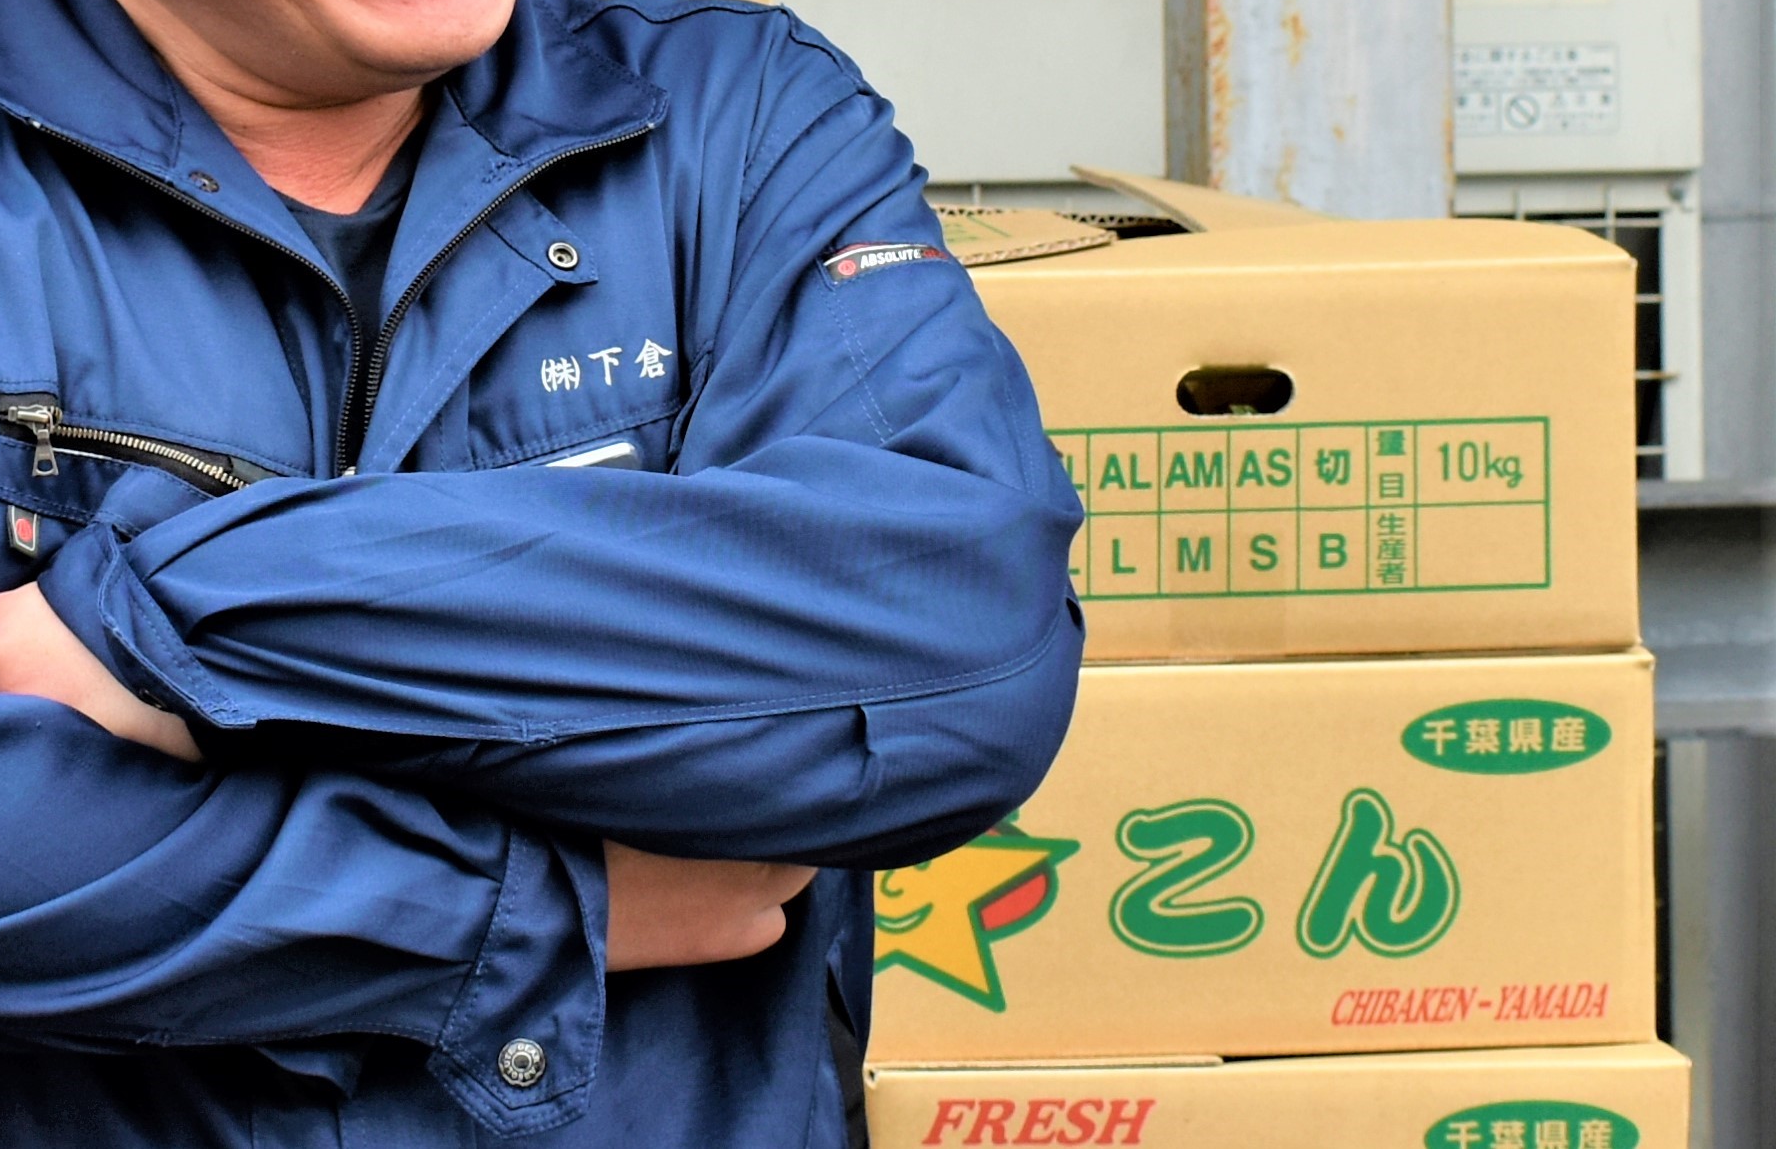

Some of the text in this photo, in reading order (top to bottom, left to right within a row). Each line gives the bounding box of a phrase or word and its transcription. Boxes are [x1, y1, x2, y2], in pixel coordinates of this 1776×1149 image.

[860, 249, 922, 269] ABSOLUTE
[1099, 453, 1153, 490] AL
[1165, 451, 1224, 488] AM
[1236, 448, 1293, 488] AS
[1315, 448, 1352, 486] 切
[1439, 441, 1524, 489] 10kg
[1111, 538, 1138, 574] L
[1177, 536, 1212, 573] M
[1250, 533, 1279, 572] S
[1318, 532, 1349, 570] B
[1376, 513, 1407, 585] 生産者
[1422, 718, 1588, 754] 千葉県産
[1109, 787, 1462, 959] こん
[922, 1098, 1155, 1146] FRESH
[1445, 1120, 1614, 1149] 千葉県産
